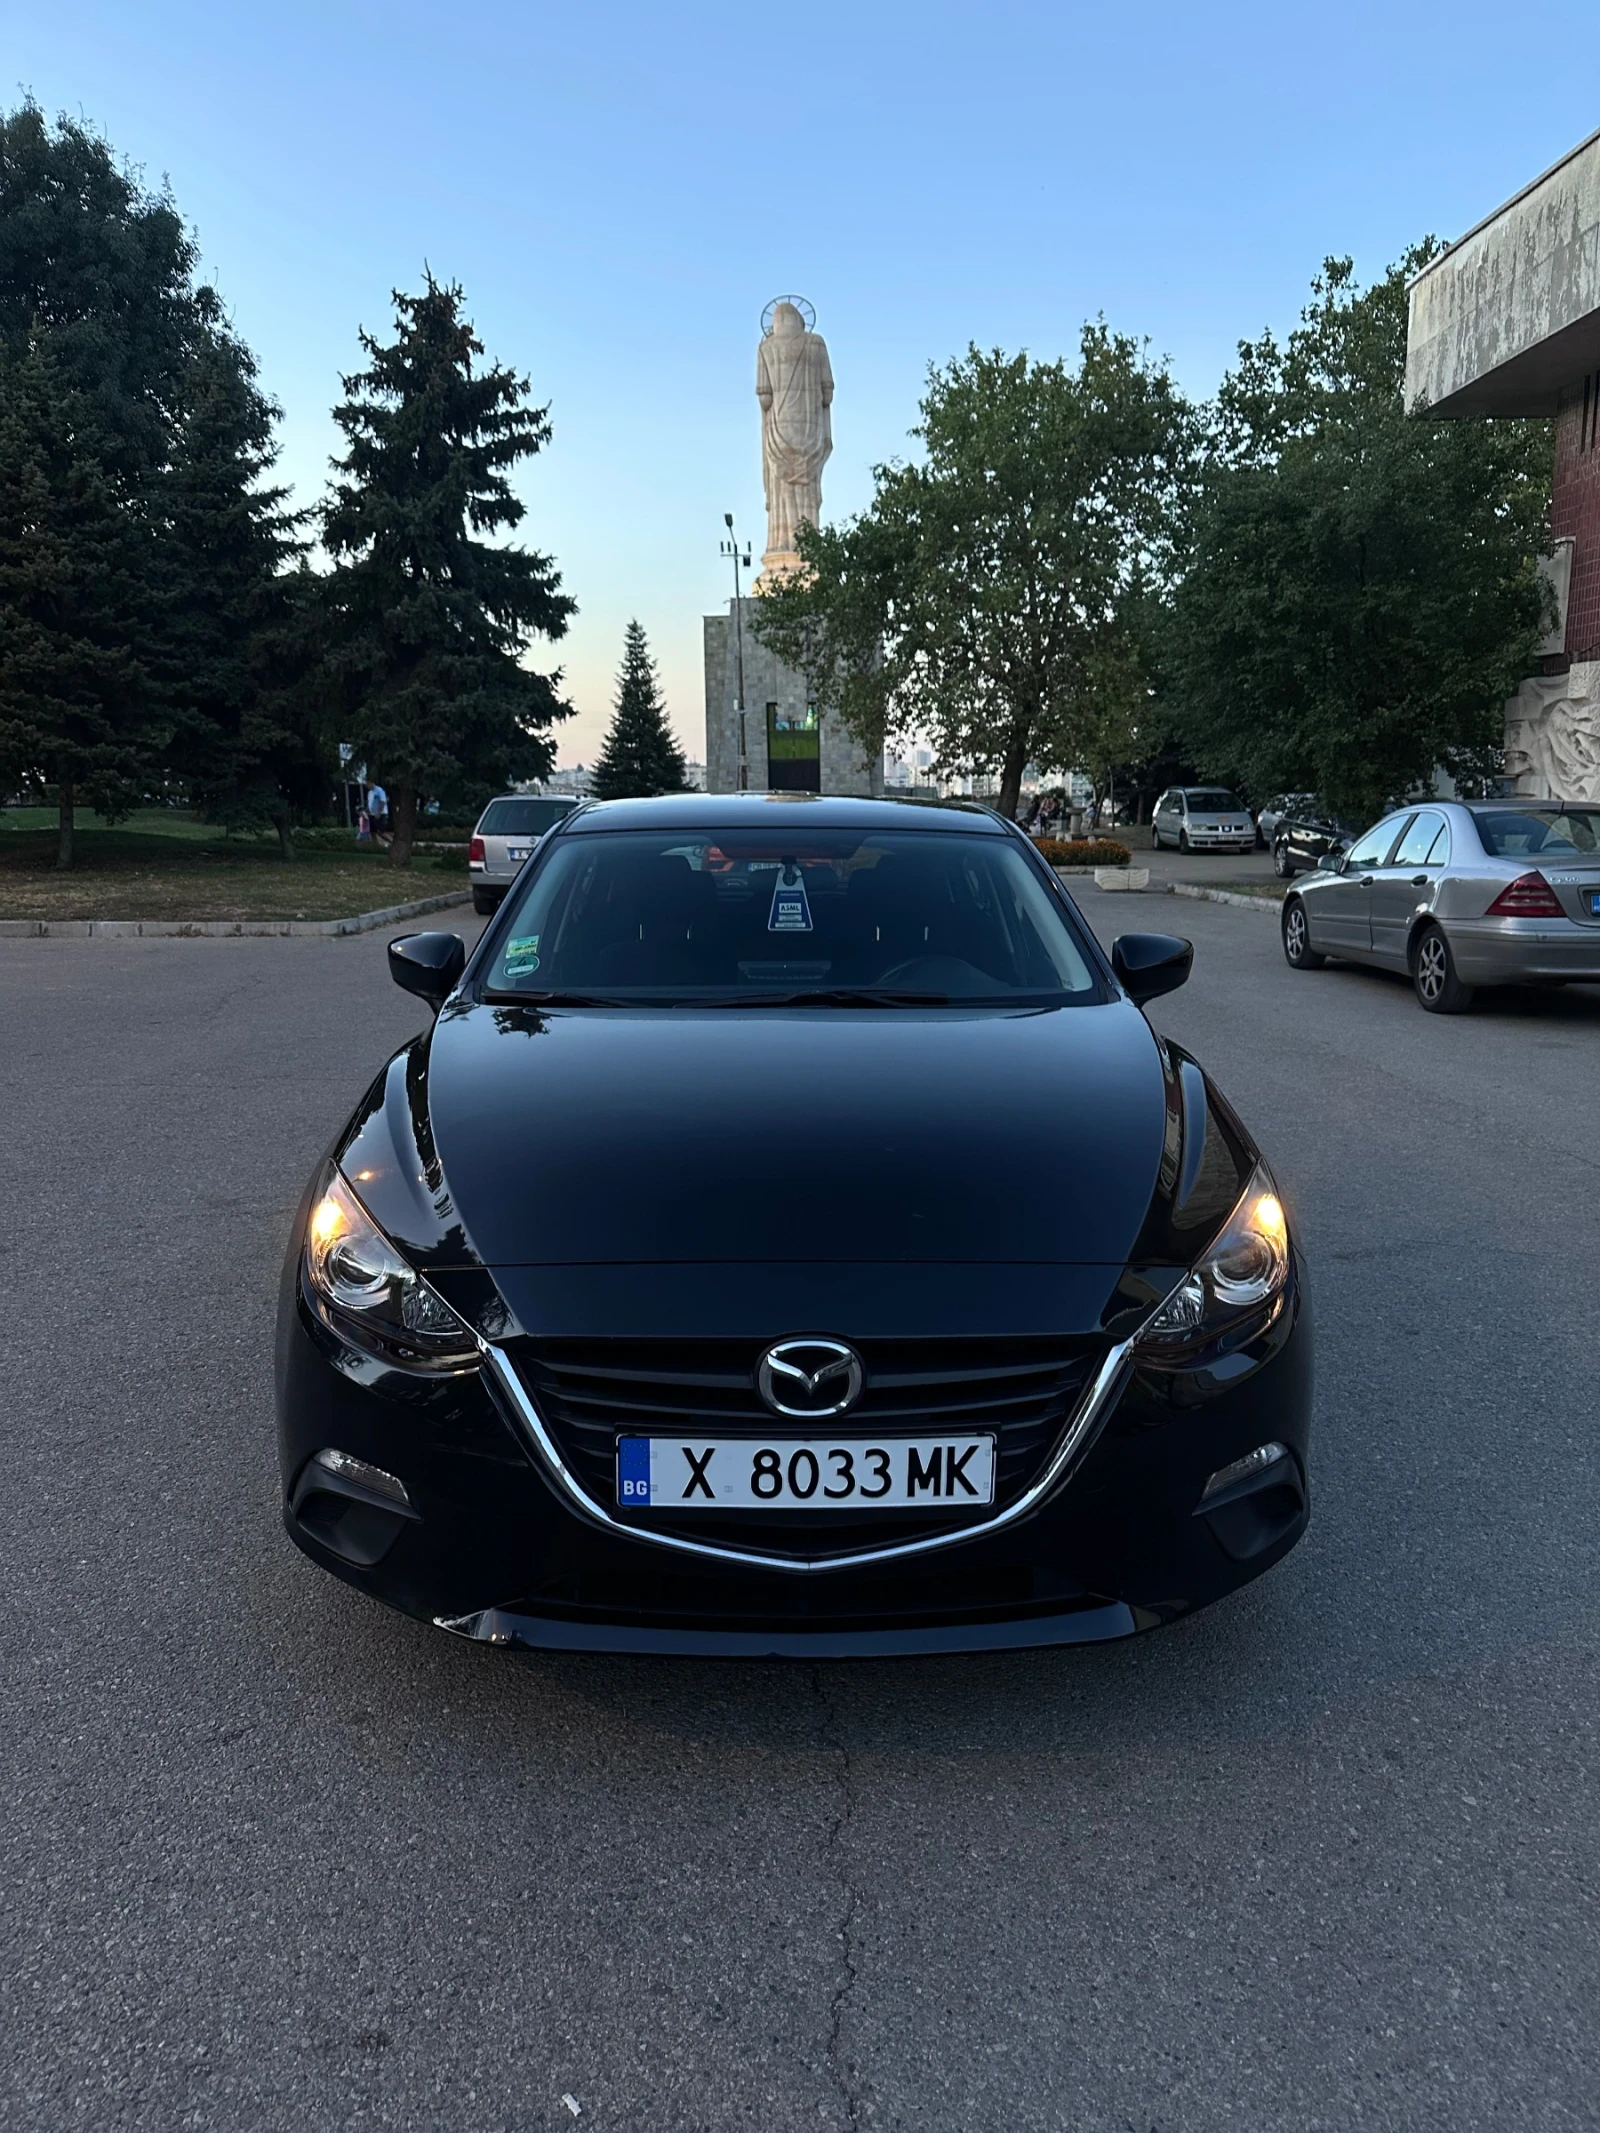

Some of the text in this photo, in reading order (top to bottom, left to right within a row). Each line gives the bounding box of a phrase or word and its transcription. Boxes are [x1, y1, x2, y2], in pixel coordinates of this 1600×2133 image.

[781, 904, 800, 912] ASML
[624, 1445, 980, 1500] BG X 8033 MK
